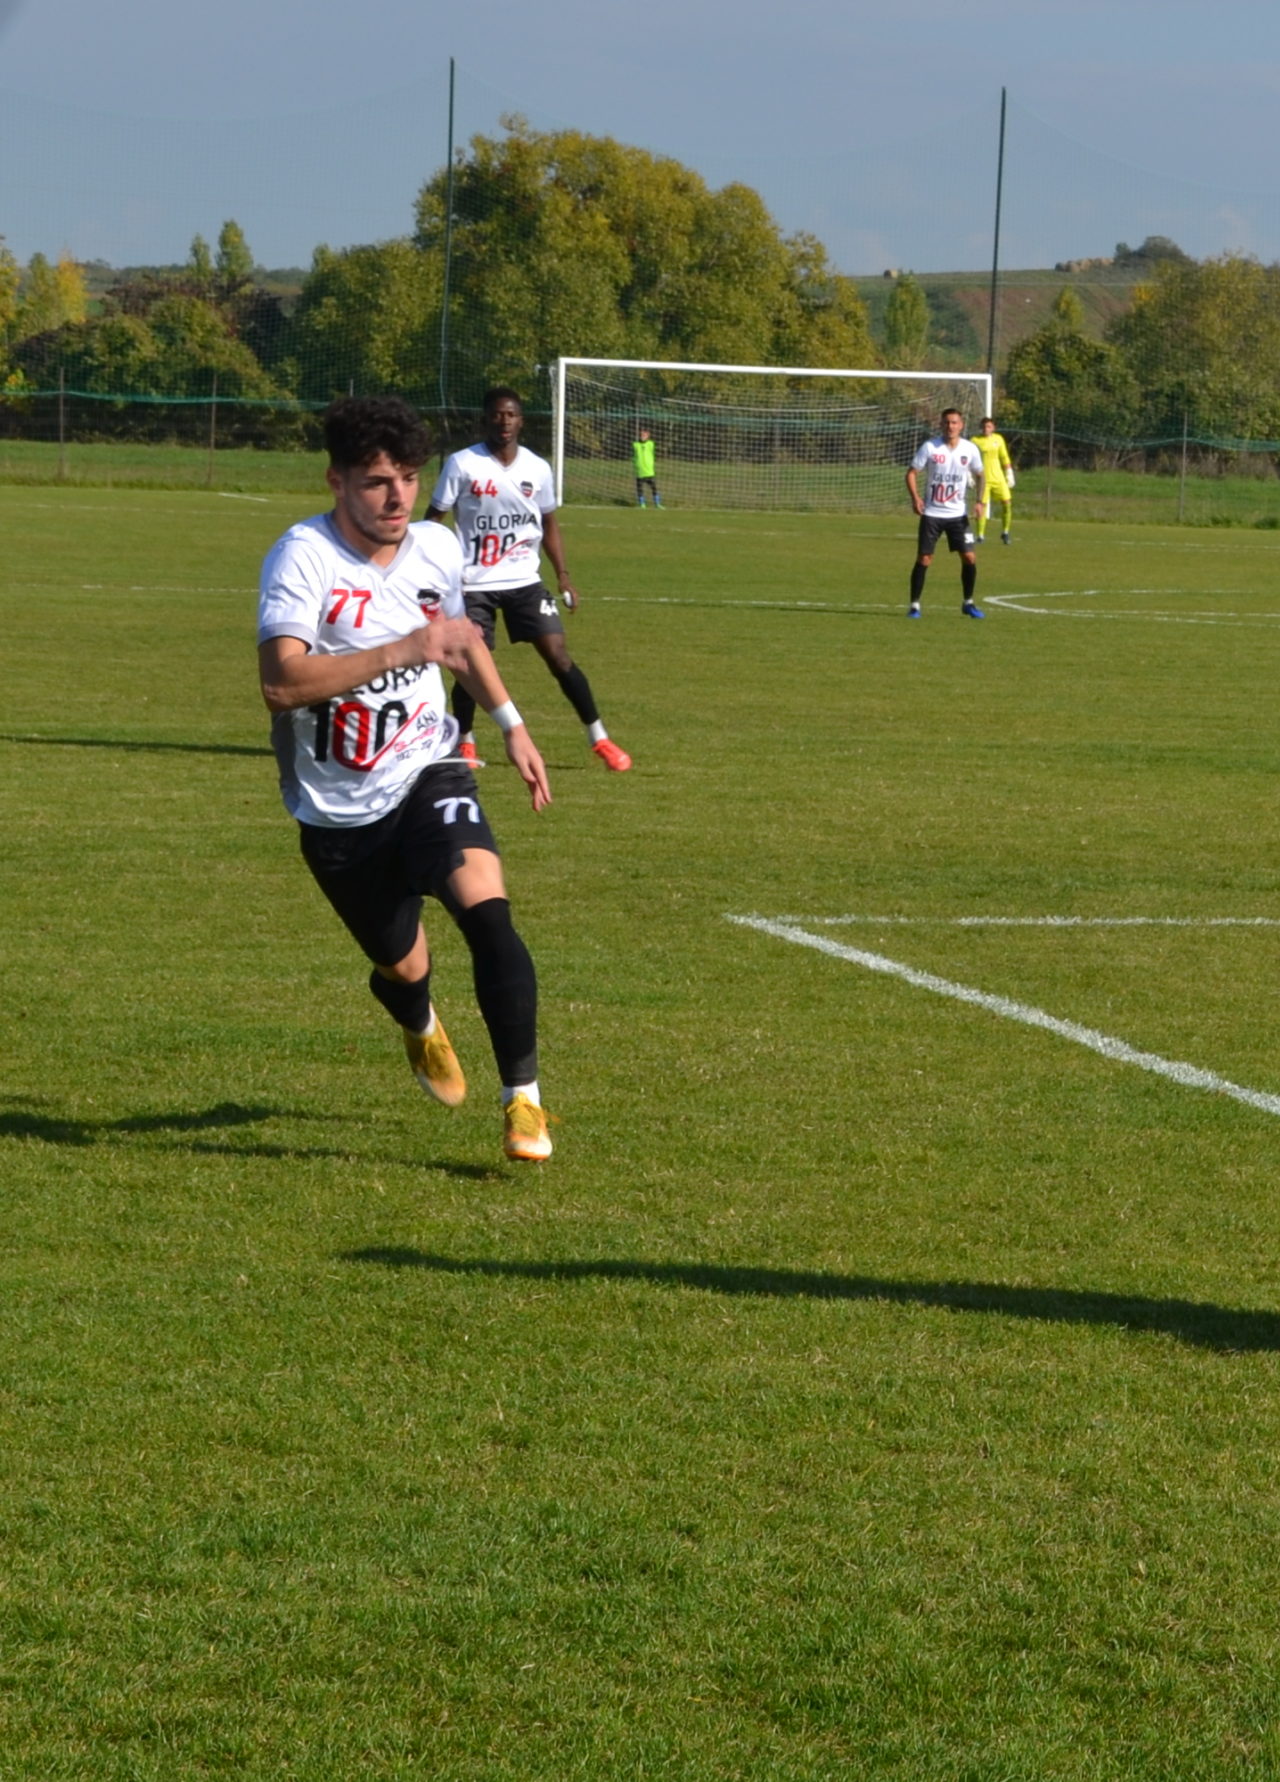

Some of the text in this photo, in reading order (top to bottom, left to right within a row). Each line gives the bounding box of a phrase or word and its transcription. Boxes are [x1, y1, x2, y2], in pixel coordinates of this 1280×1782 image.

[932, 453, 946, 465] 30
[470, 478, 499, 498] 44
[930, 483, 955, 504] 100
[476, 513, 538, 531] GLORIA
[470, 531, 517, 568] 100
[326, 588, 373, 629] 77
[308, 699, 410, 773] 100
[433, 796, 481, 824] 77
